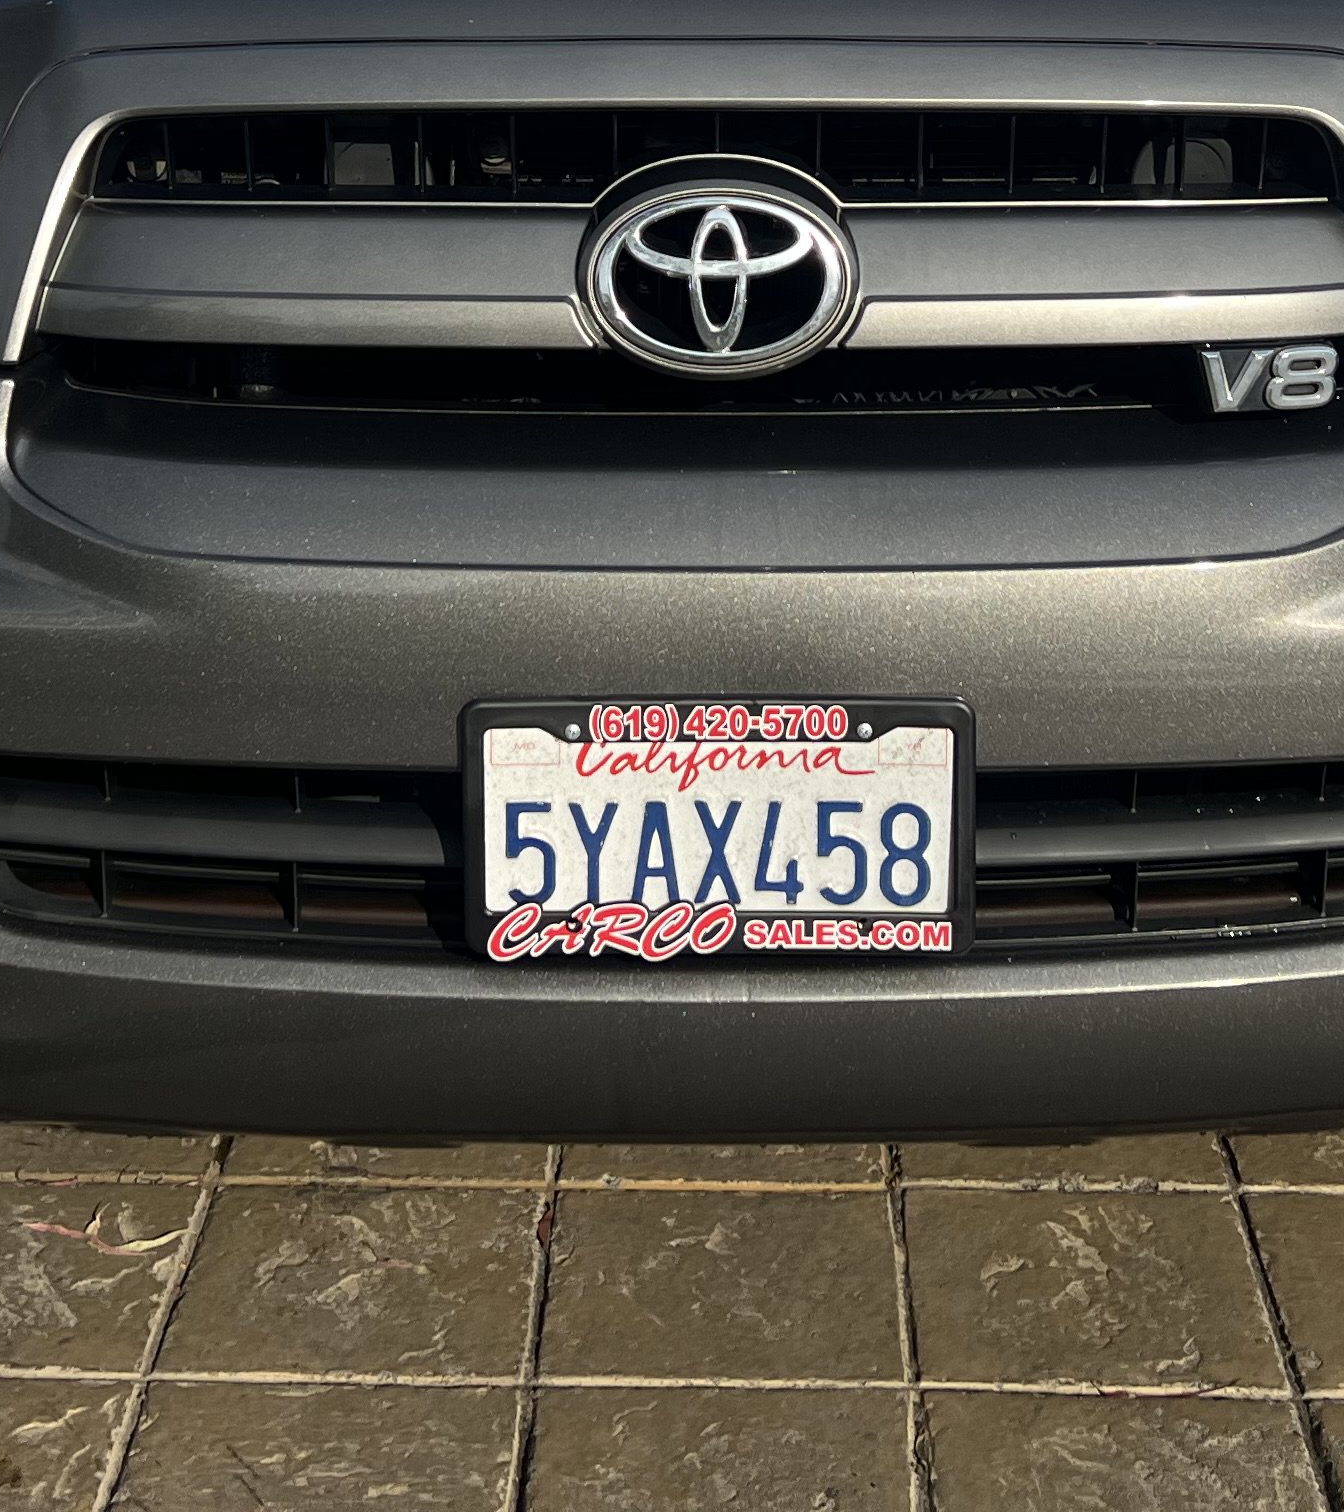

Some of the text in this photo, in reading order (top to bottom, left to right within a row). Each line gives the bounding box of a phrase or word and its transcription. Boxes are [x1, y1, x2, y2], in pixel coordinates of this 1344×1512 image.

[1201, 344, 1339, 412] V8
[589, 705, 849, 742] (619) 420-5700
[575, 741, 875, 792] California
[505, 799, 932, 906] 5YAX458
[488, 900, 952, 962] CARCO SALES.COM
